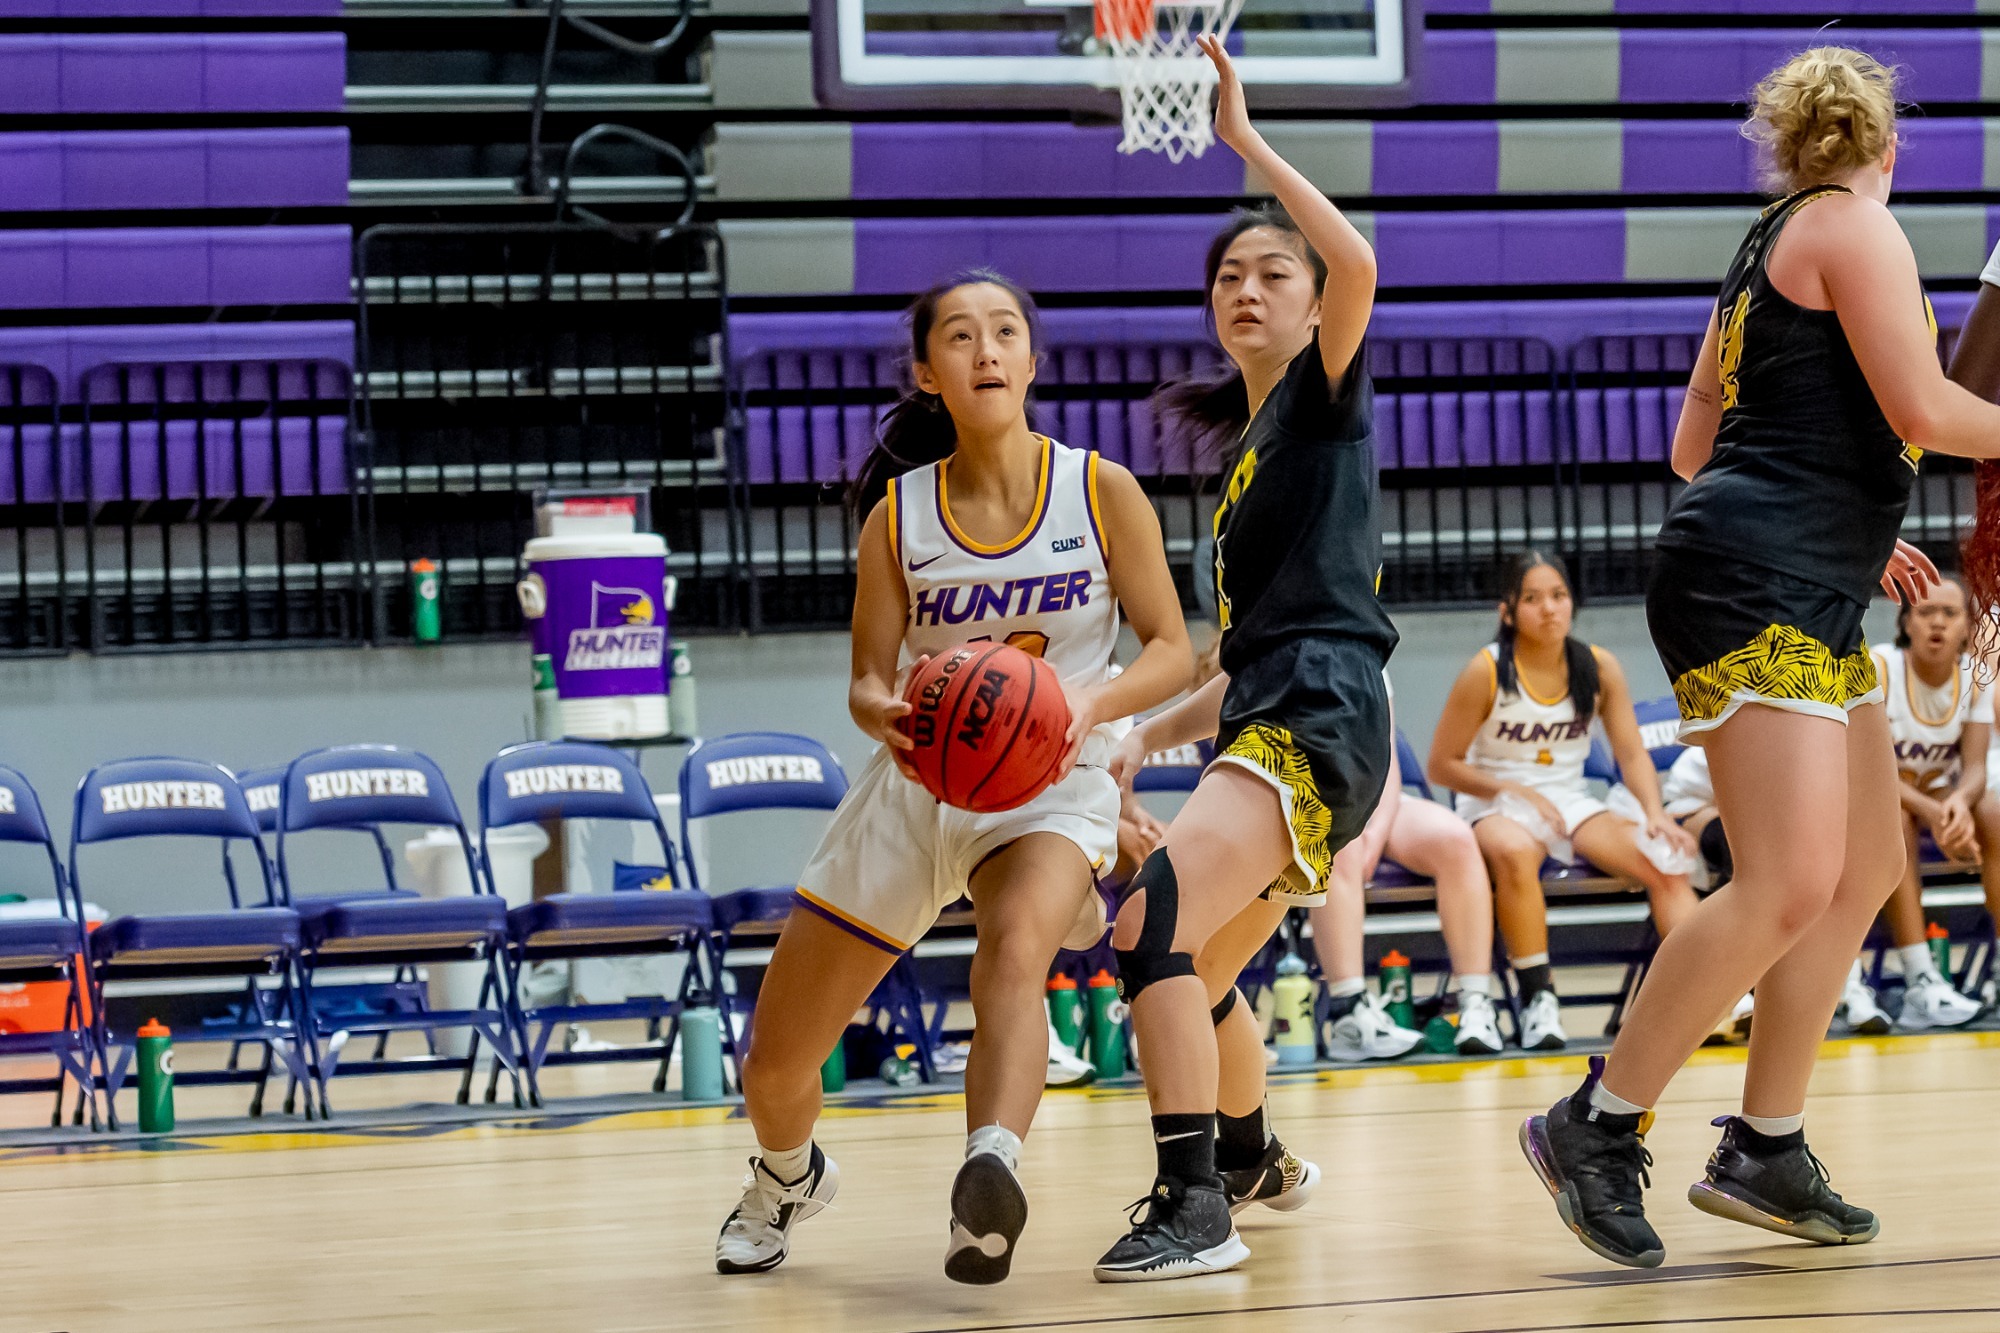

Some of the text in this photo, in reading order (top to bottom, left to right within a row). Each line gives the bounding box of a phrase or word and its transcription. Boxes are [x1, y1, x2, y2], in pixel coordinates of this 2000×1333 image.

[1051, 534, 1086, 552] CUNY
[915, 569, 1093, 627] HUNTER
[573, 631, 660, 655] HUNTER
[957, 669, 1010, 752] NCAA
[305, 768, 429, 802] HUNTER
[504, 765, 624, 798] HUNTER
[707, 755, 824, 789] HUNTER
[101, 781, 226, 814] HUNTER
